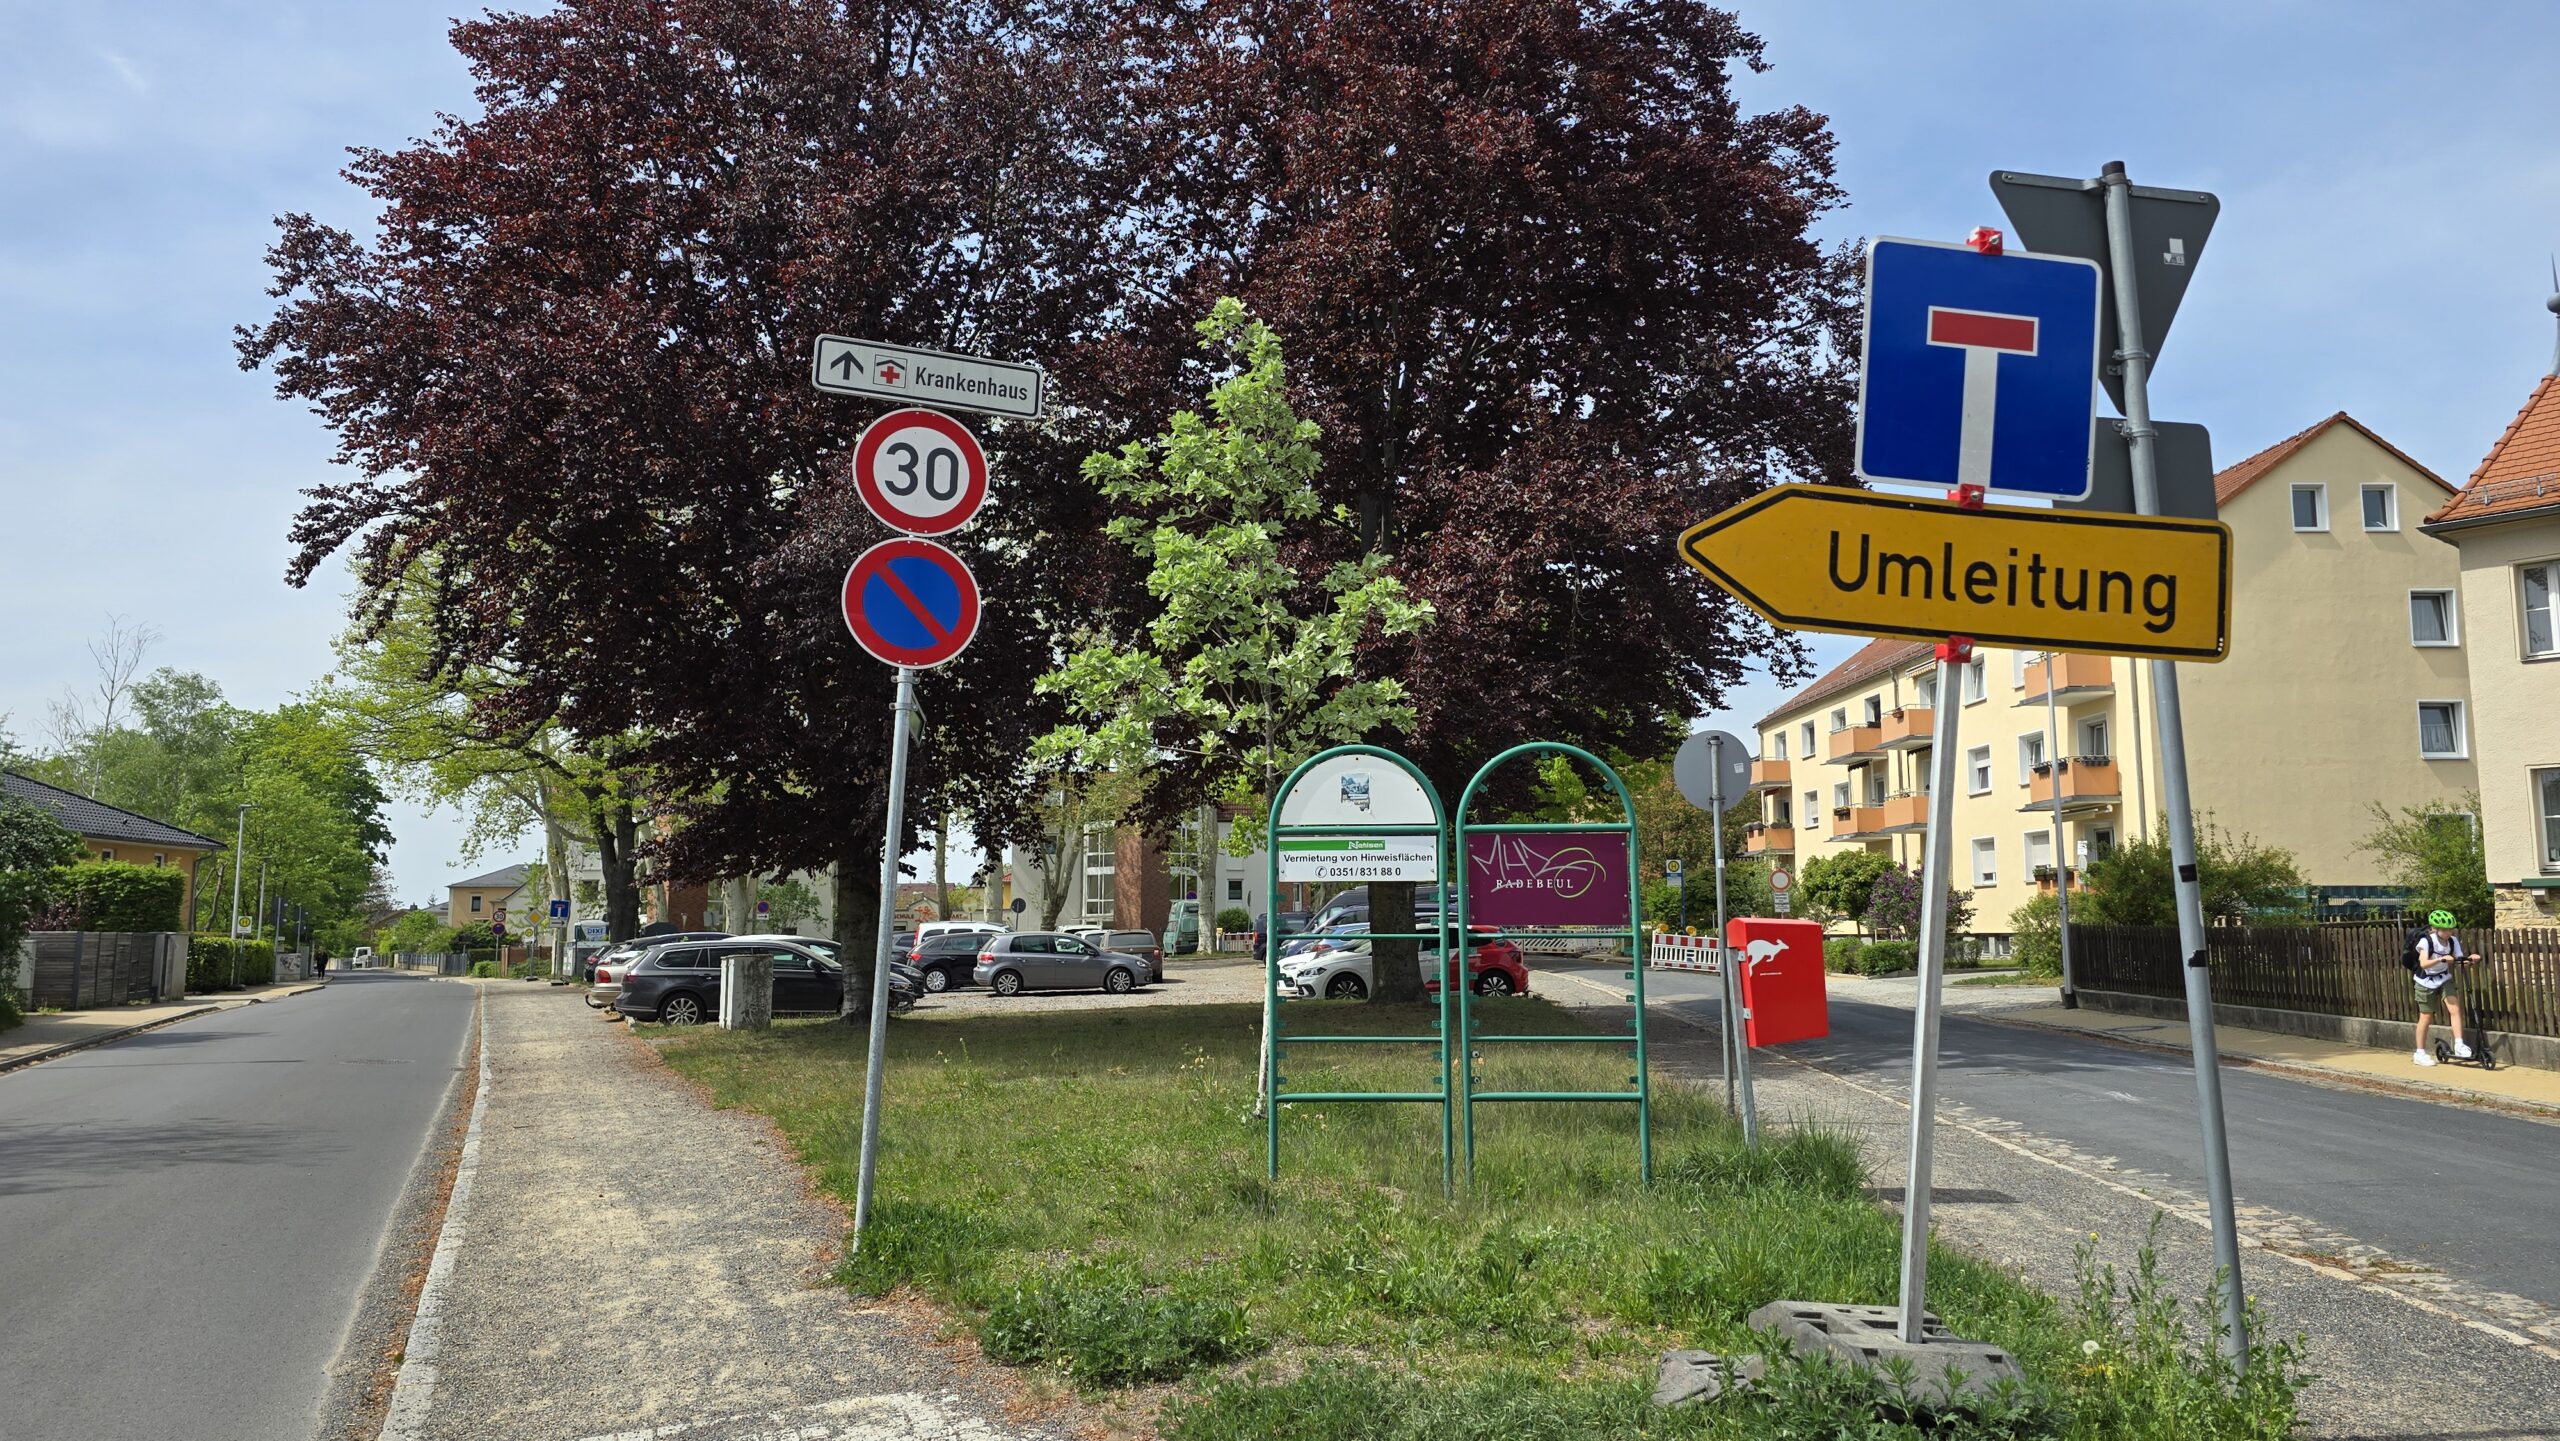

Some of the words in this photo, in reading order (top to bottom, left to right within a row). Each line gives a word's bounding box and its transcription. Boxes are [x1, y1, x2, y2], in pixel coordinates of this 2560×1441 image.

[915, 366, 1028, 401] Krankenhaus
[884, 442, 960, 501] 30
[1829, 530, 2177, 634] Umleitung
[1284, 854, 1338, 864] Vermietung
[1361, 853, 1433, 862] Hinweisflächen
[1330, 868, 1378, 876] 0351/831
[1381, 867, 1392, 876] 88
[1395, 867, 1401, 876] 0
[1496, 879, 1574, 889] RADEBEUL
